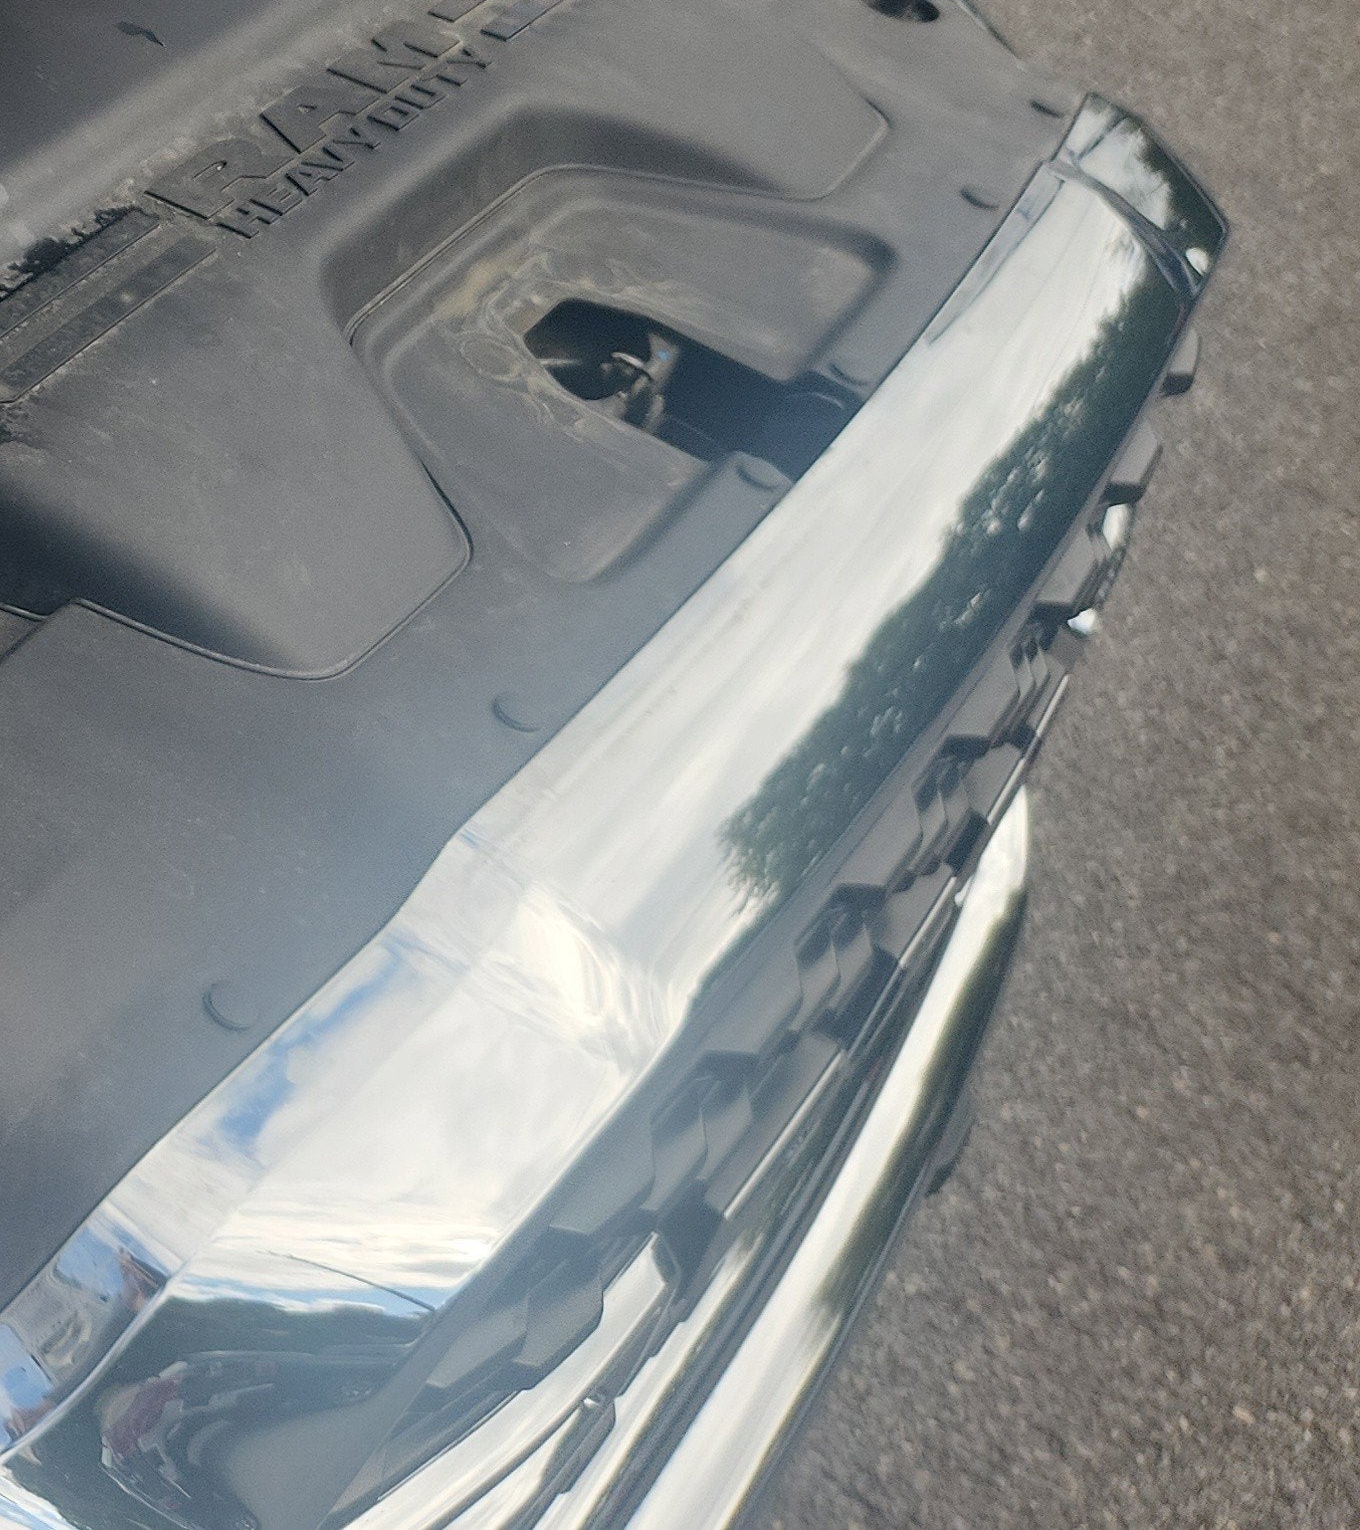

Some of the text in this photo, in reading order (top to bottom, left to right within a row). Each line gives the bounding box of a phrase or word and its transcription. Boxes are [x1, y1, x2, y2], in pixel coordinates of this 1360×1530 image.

[143, 22, 461, 220] RAM
[215, 47, 493, 239] HEAVY DUTY
